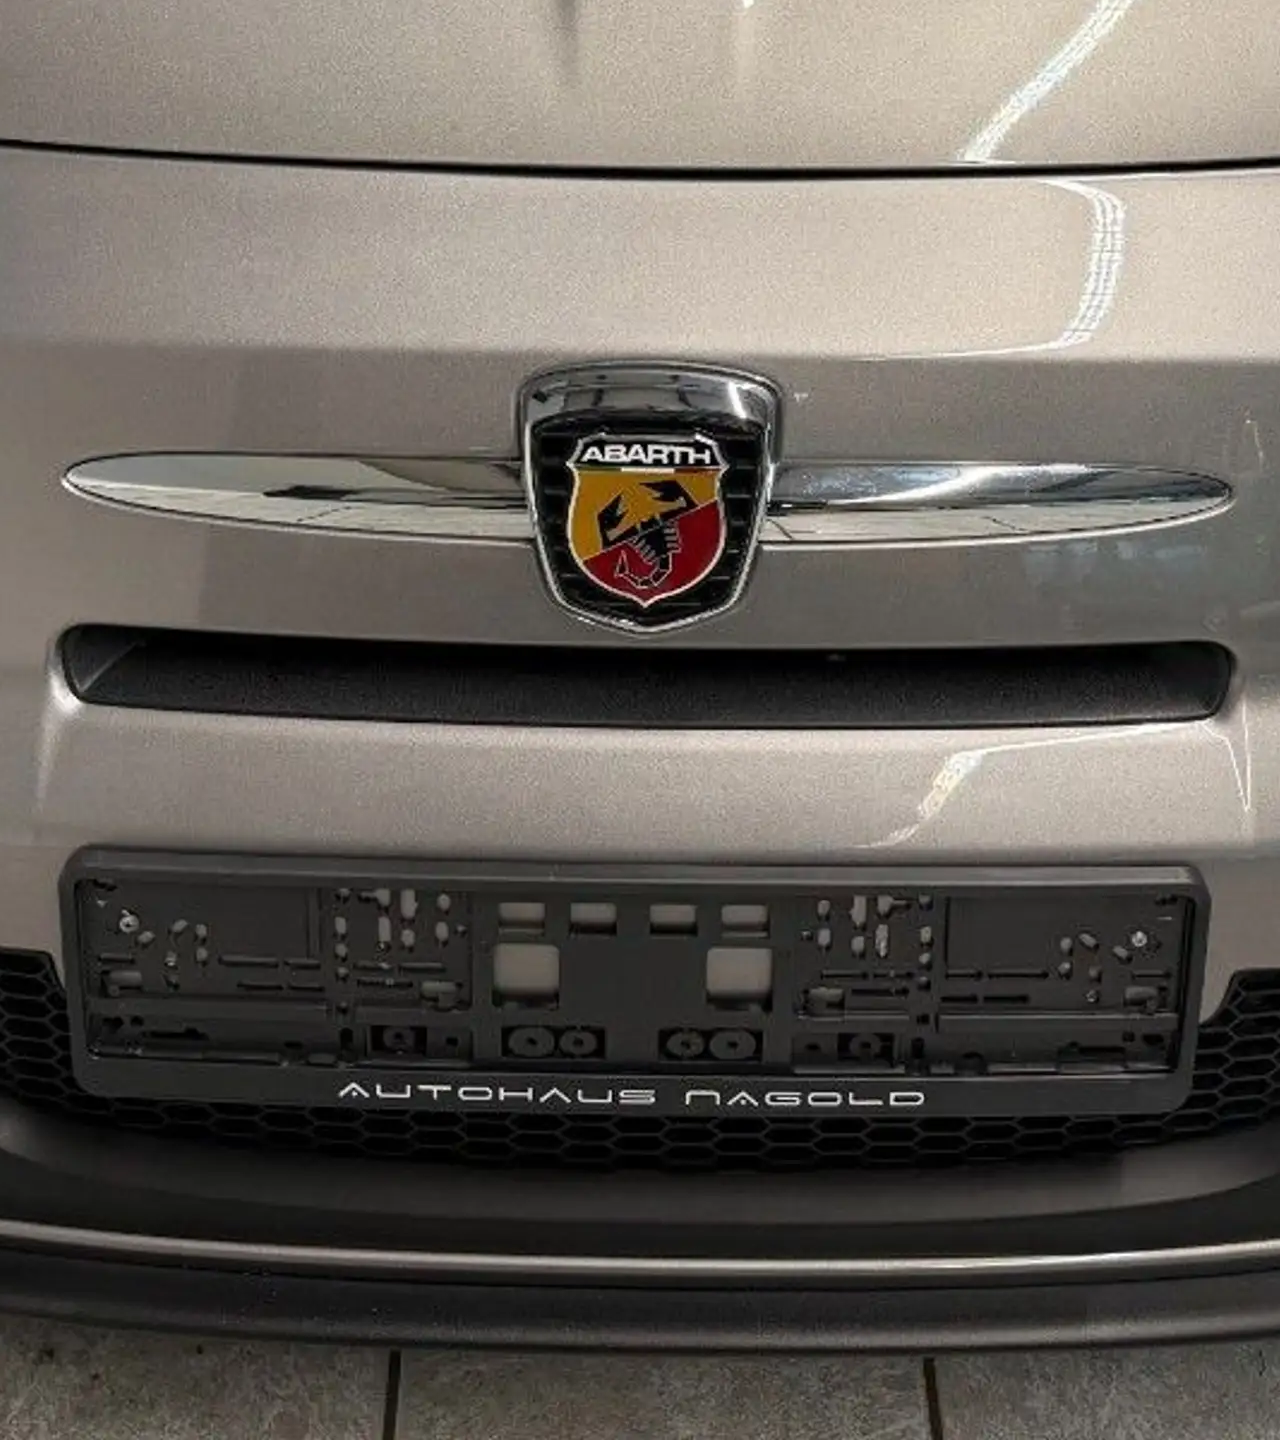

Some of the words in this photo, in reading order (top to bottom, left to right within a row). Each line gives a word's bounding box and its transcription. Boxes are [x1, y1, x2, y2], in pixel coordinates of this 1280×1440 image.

[581, 443, 711, 465] ABARTH
[338, 1081, 656, 1105] AUTOHAUS
[684, 1089, 925, 1107] NAGOLD
